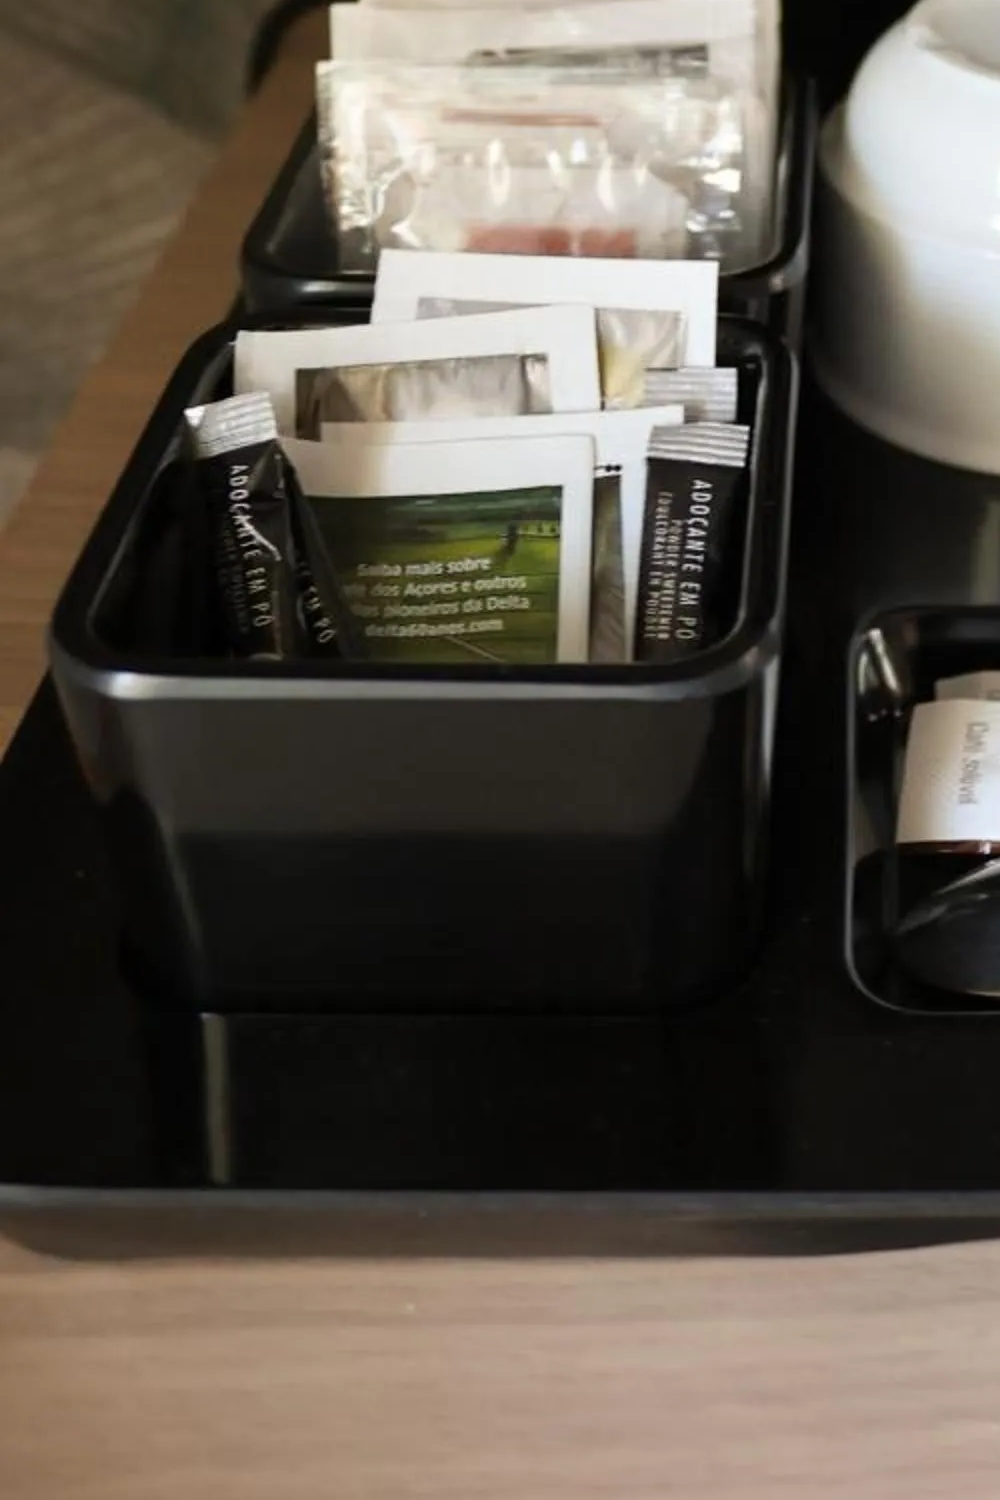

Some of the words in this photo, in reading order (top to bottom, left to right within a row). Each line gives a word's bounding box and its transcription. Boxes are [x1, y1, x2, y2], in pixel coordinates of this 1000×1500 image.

[681, 479, 713, 572] ADOÇANTE
[666, 519, 683, 567] POWDER
[405, 561, 443, 576] mais
[446, 557, 492, 574] sobre
[246, 567, 266, 595] EM
[404, 581, 457, 598] Açores
[461, 582, 472, 592] e
[474, 576, 527, 591] outros
[649, 571, 662, 585] EN
[463, 599, 482, 612] da
[486, 596, 530, 611] Delta
[679, 582, 701, 605] EM
[656, 572, 677, 639] SWEETENER
[675, 617, 699, 639] PÓ
